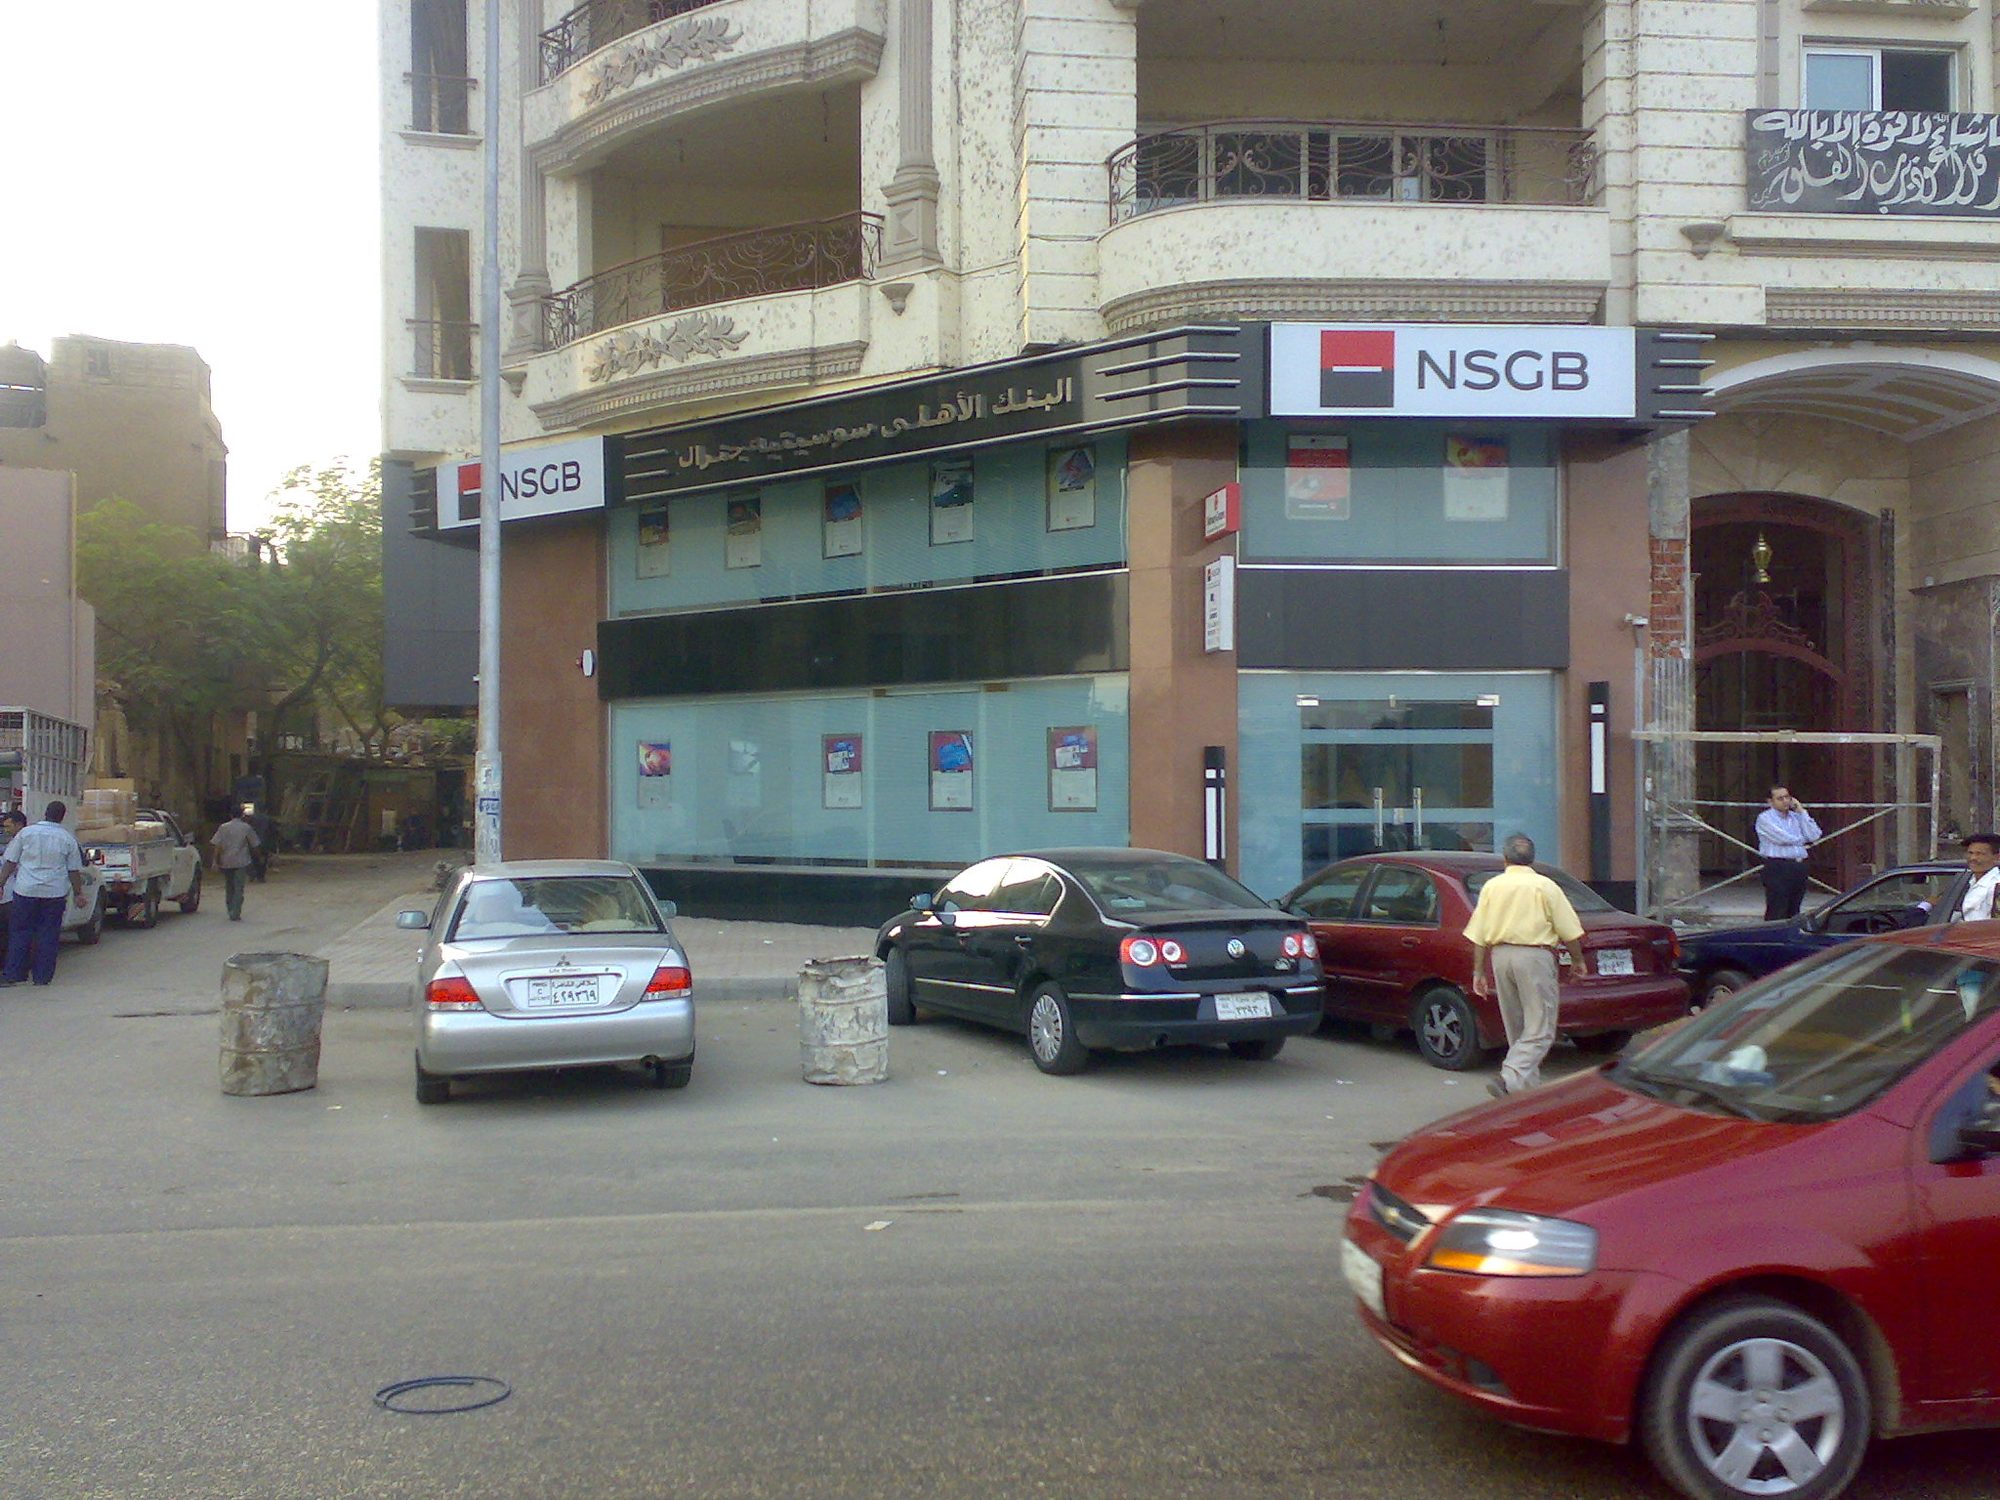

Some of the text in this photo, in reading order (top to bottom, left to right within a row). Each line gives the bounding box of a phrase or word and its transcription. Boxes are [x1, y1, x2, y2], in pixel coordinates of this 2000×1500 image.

[1752, 110, 1830, 150] بالله
[1861, 111, 1908, 151] قوة
[1896, 113, 1932, 145] لا
[1417, 349, 1589, 391] NSGB
[992, 376, 1072, 415] البنك
[500, 461, 581, 502] NSGB
